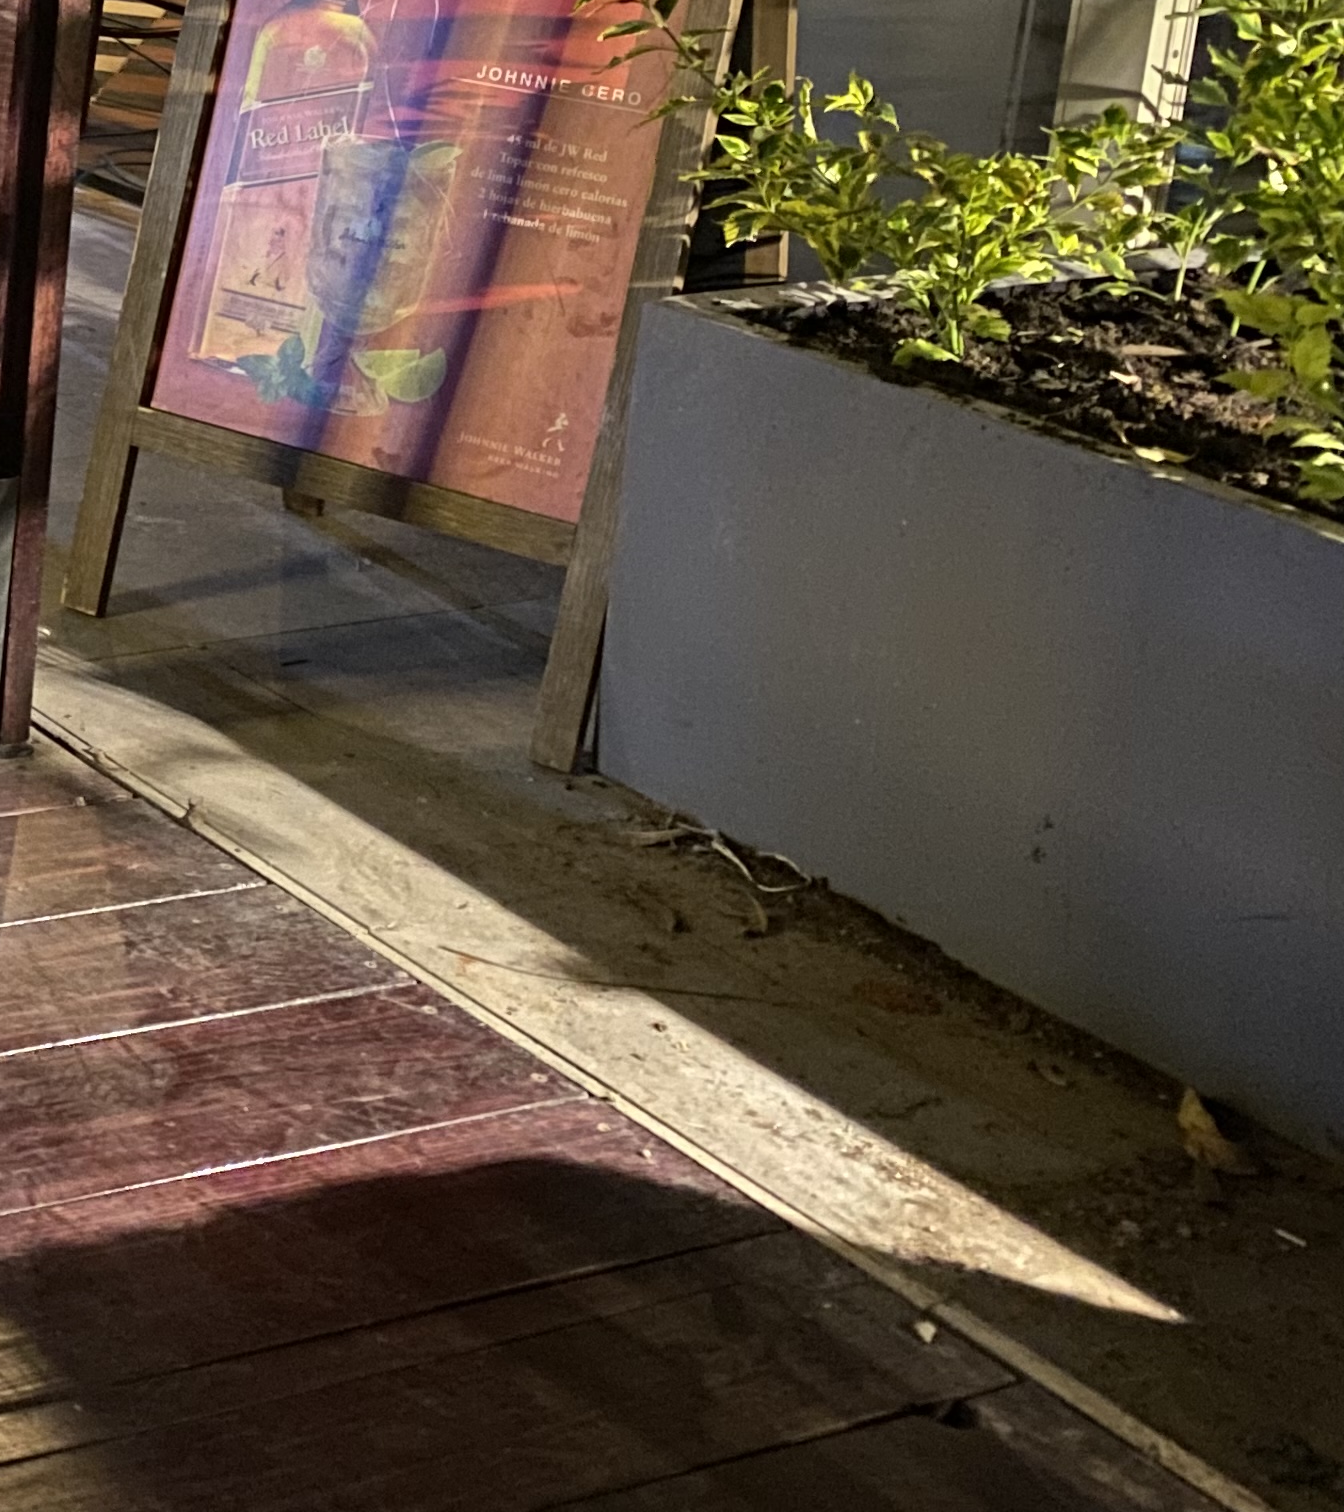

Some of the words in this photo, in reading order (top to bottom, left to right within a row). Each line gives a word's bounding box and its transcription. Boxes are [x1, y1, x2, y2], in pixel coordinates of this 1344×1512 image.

[476, 65, 571, 92] JOHNNIE
[581, 84, 642, 105] CERO
[250, 124, 289, 149] Red
[295, 116, 350, 143] Label
[544, 139, 558, 153] de
[583, 148, 608, 162] Red
[561, 166, 608, 183] refresco
